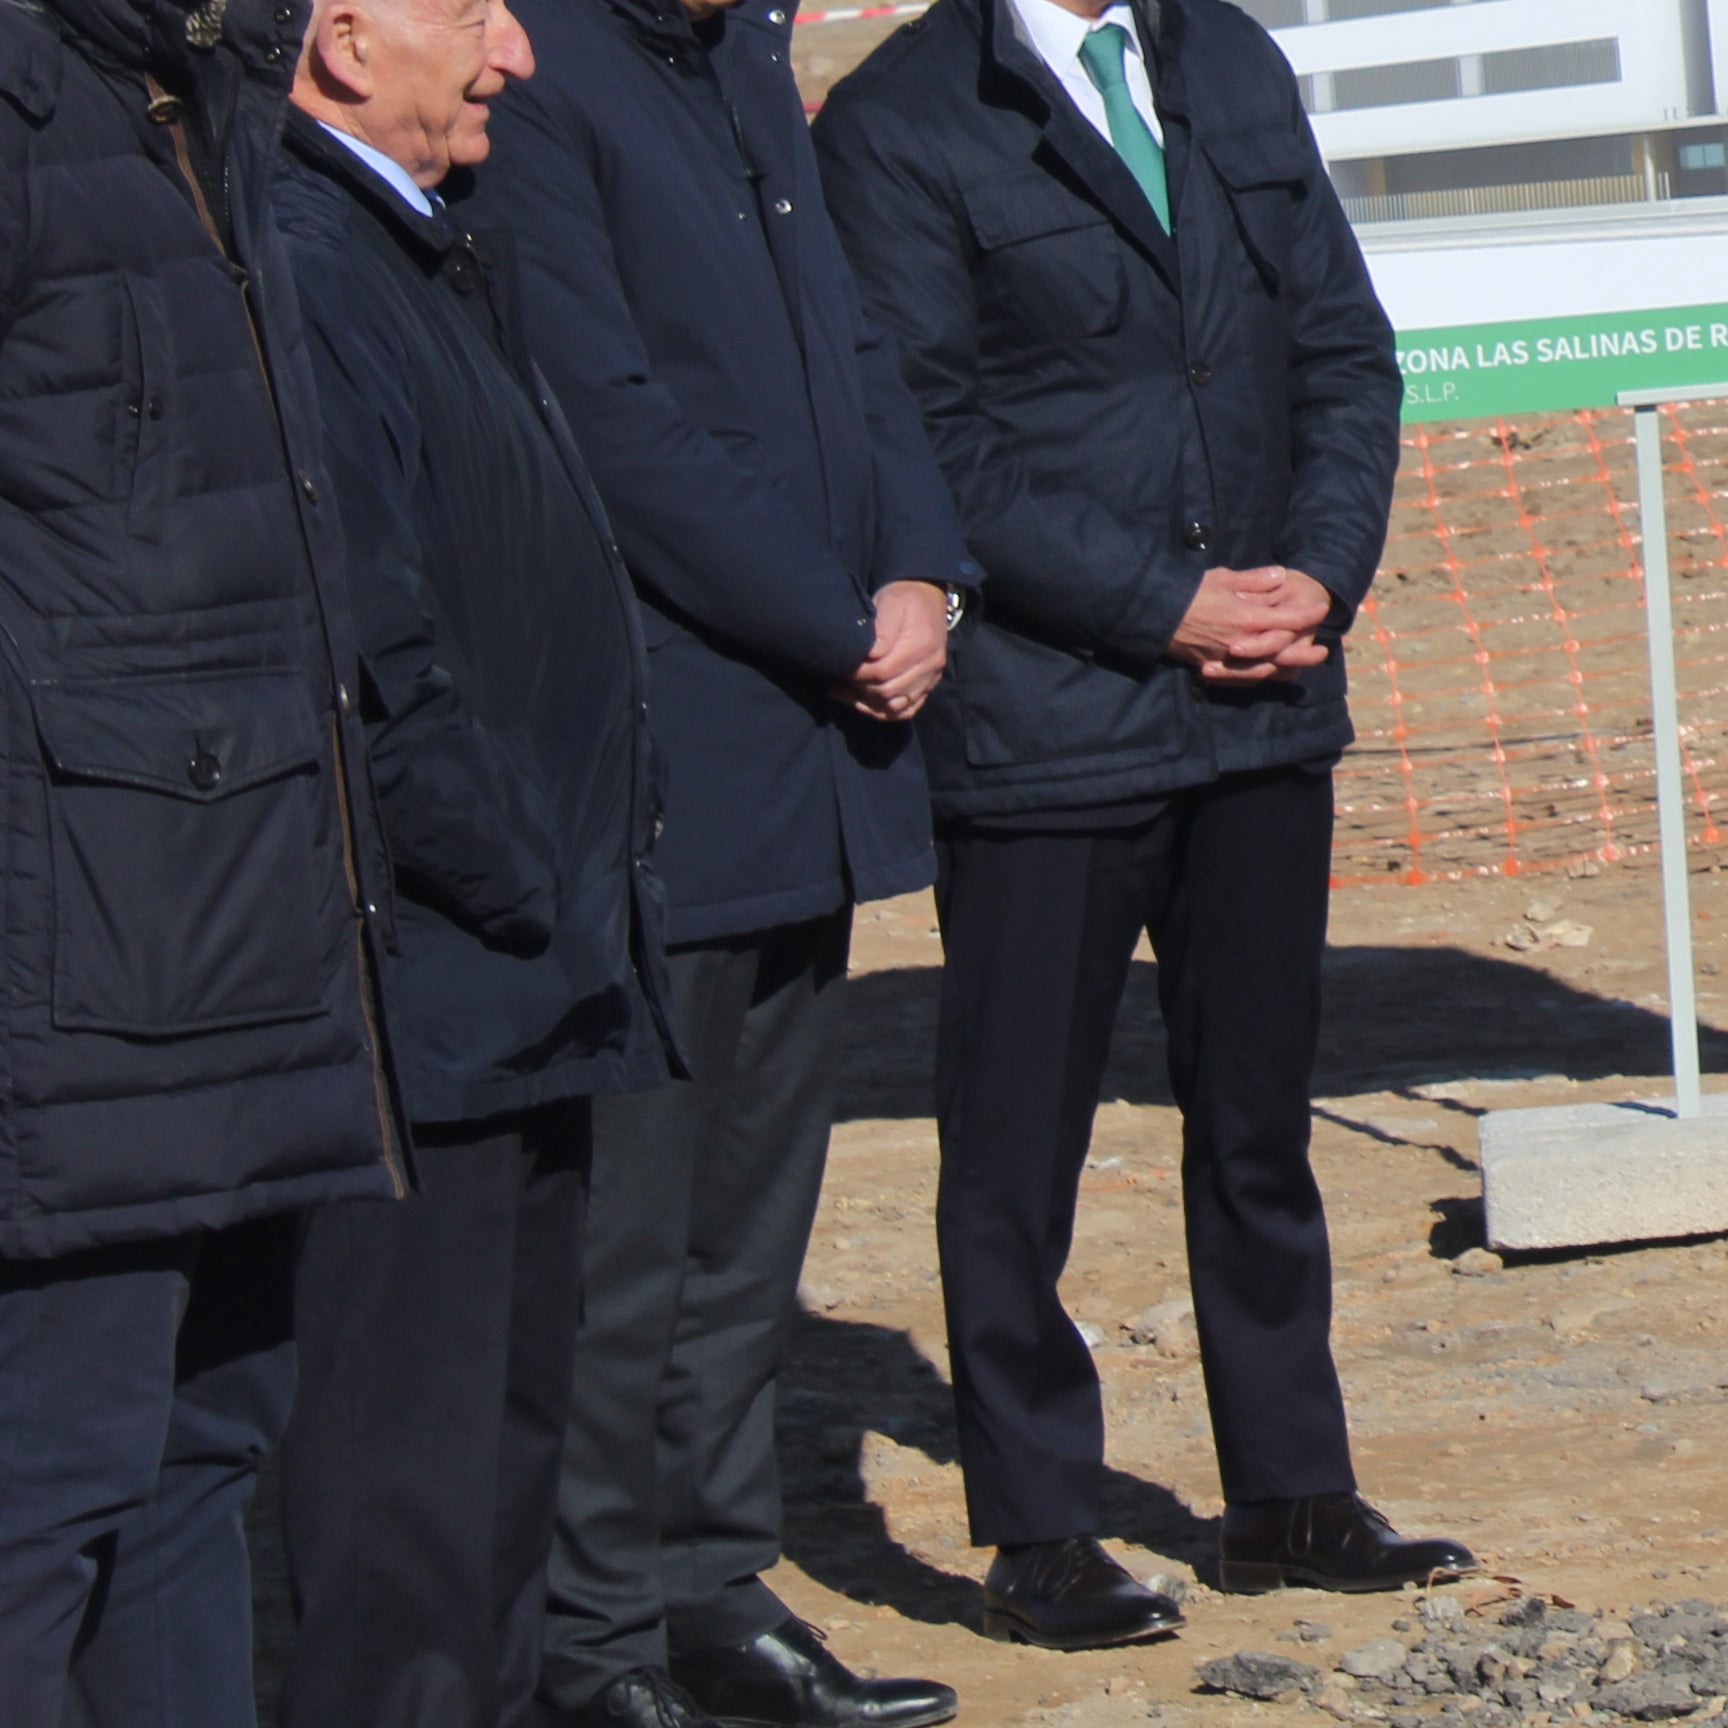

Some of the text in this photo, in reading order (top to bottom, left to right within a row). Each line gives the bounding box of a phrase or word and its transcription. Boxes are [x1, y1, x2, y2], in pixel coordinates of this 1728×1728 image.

[1476, 340, 1529, 368] LAS
[1536, 328, 1658, 363] SALINAS
[1664, 325, 1702, 352] DE
[1406, 382, 1459, 404] S.L.P.
